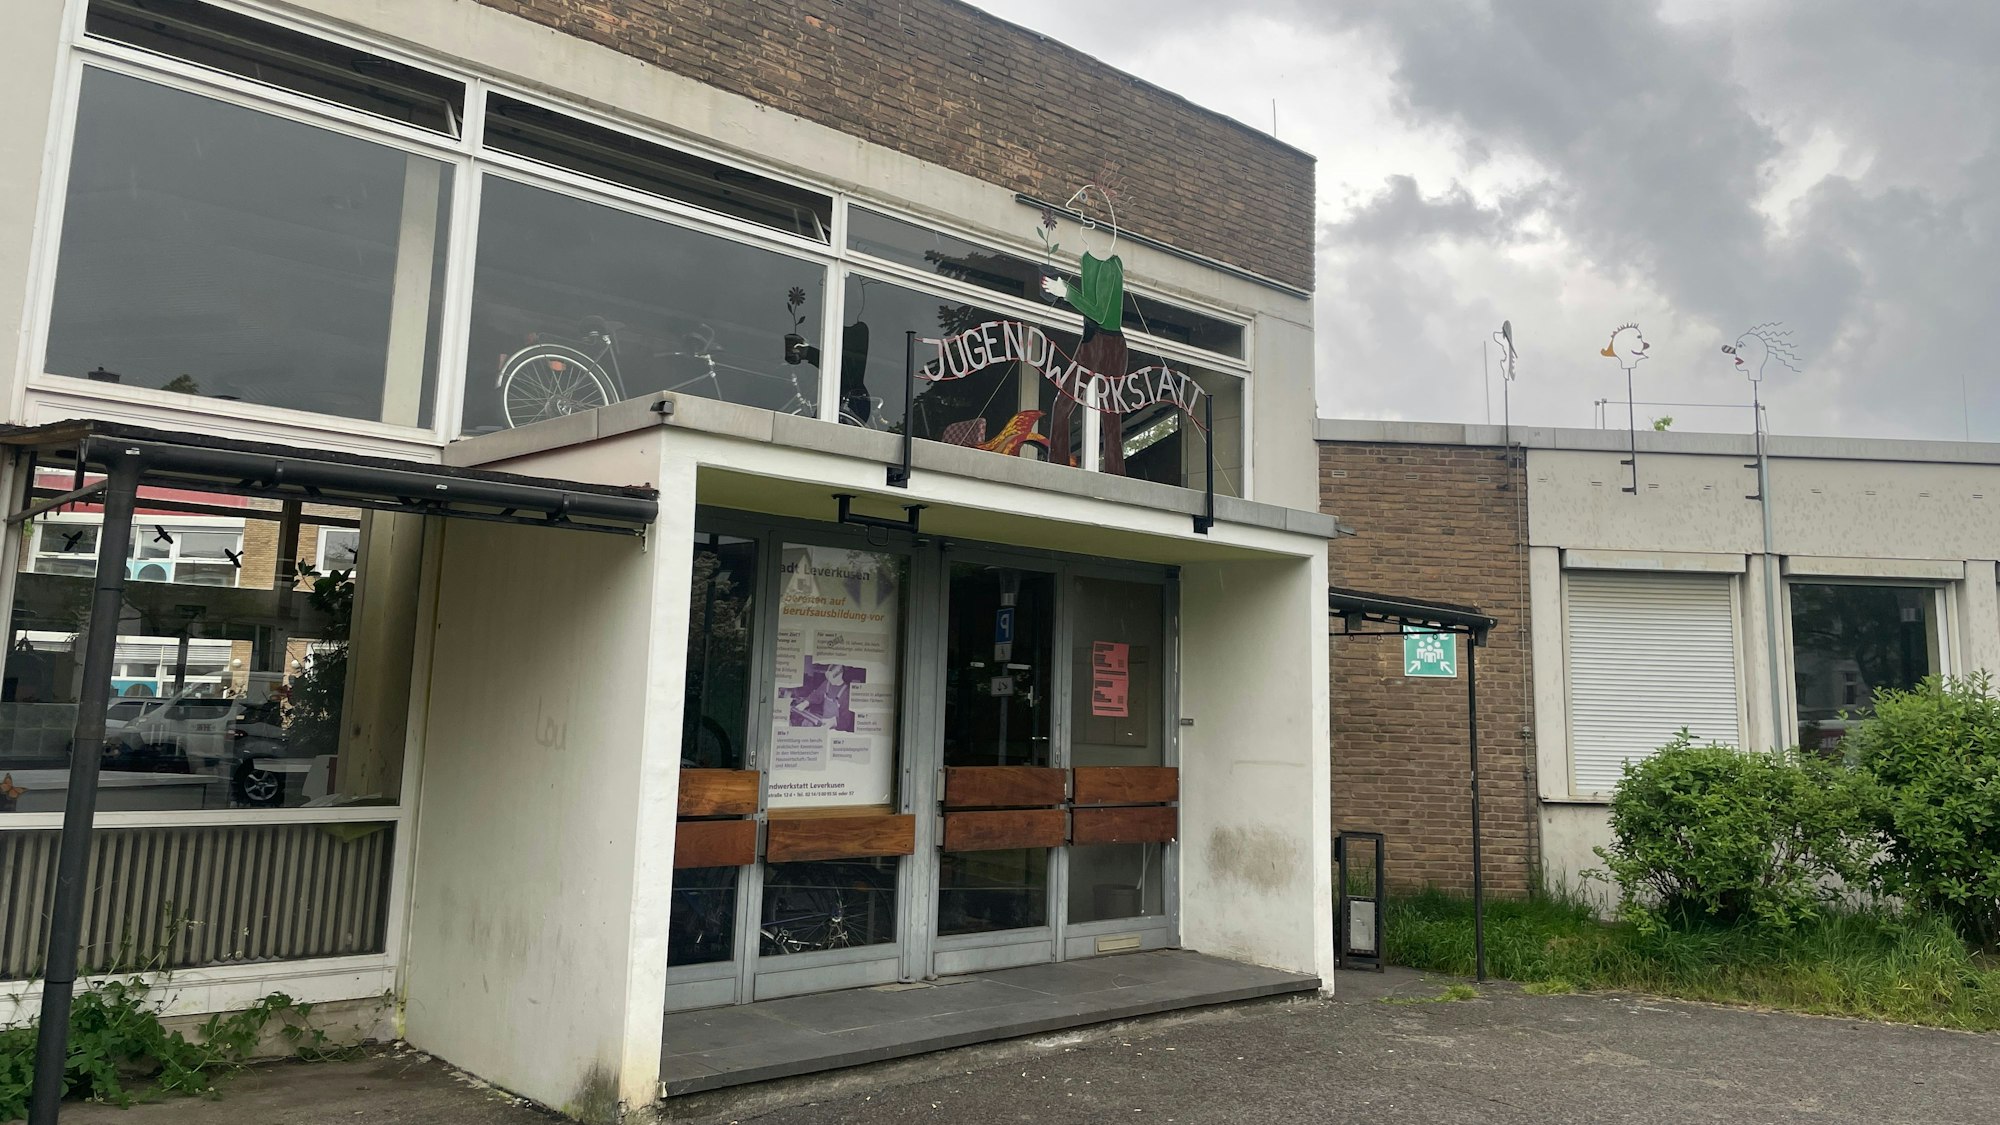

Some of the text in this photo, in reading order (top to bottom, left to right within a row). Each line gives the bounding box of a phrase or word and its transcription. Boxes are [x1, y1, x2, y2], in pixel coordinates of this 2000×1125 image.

[923, 320, 1205, 416] JUGENDWERKSTATT
[804, 564, 870, 581] Leverkusen
[830, 597, 846, 606] auf
[783, 607, 885, 623] Berufsausbildung vor
